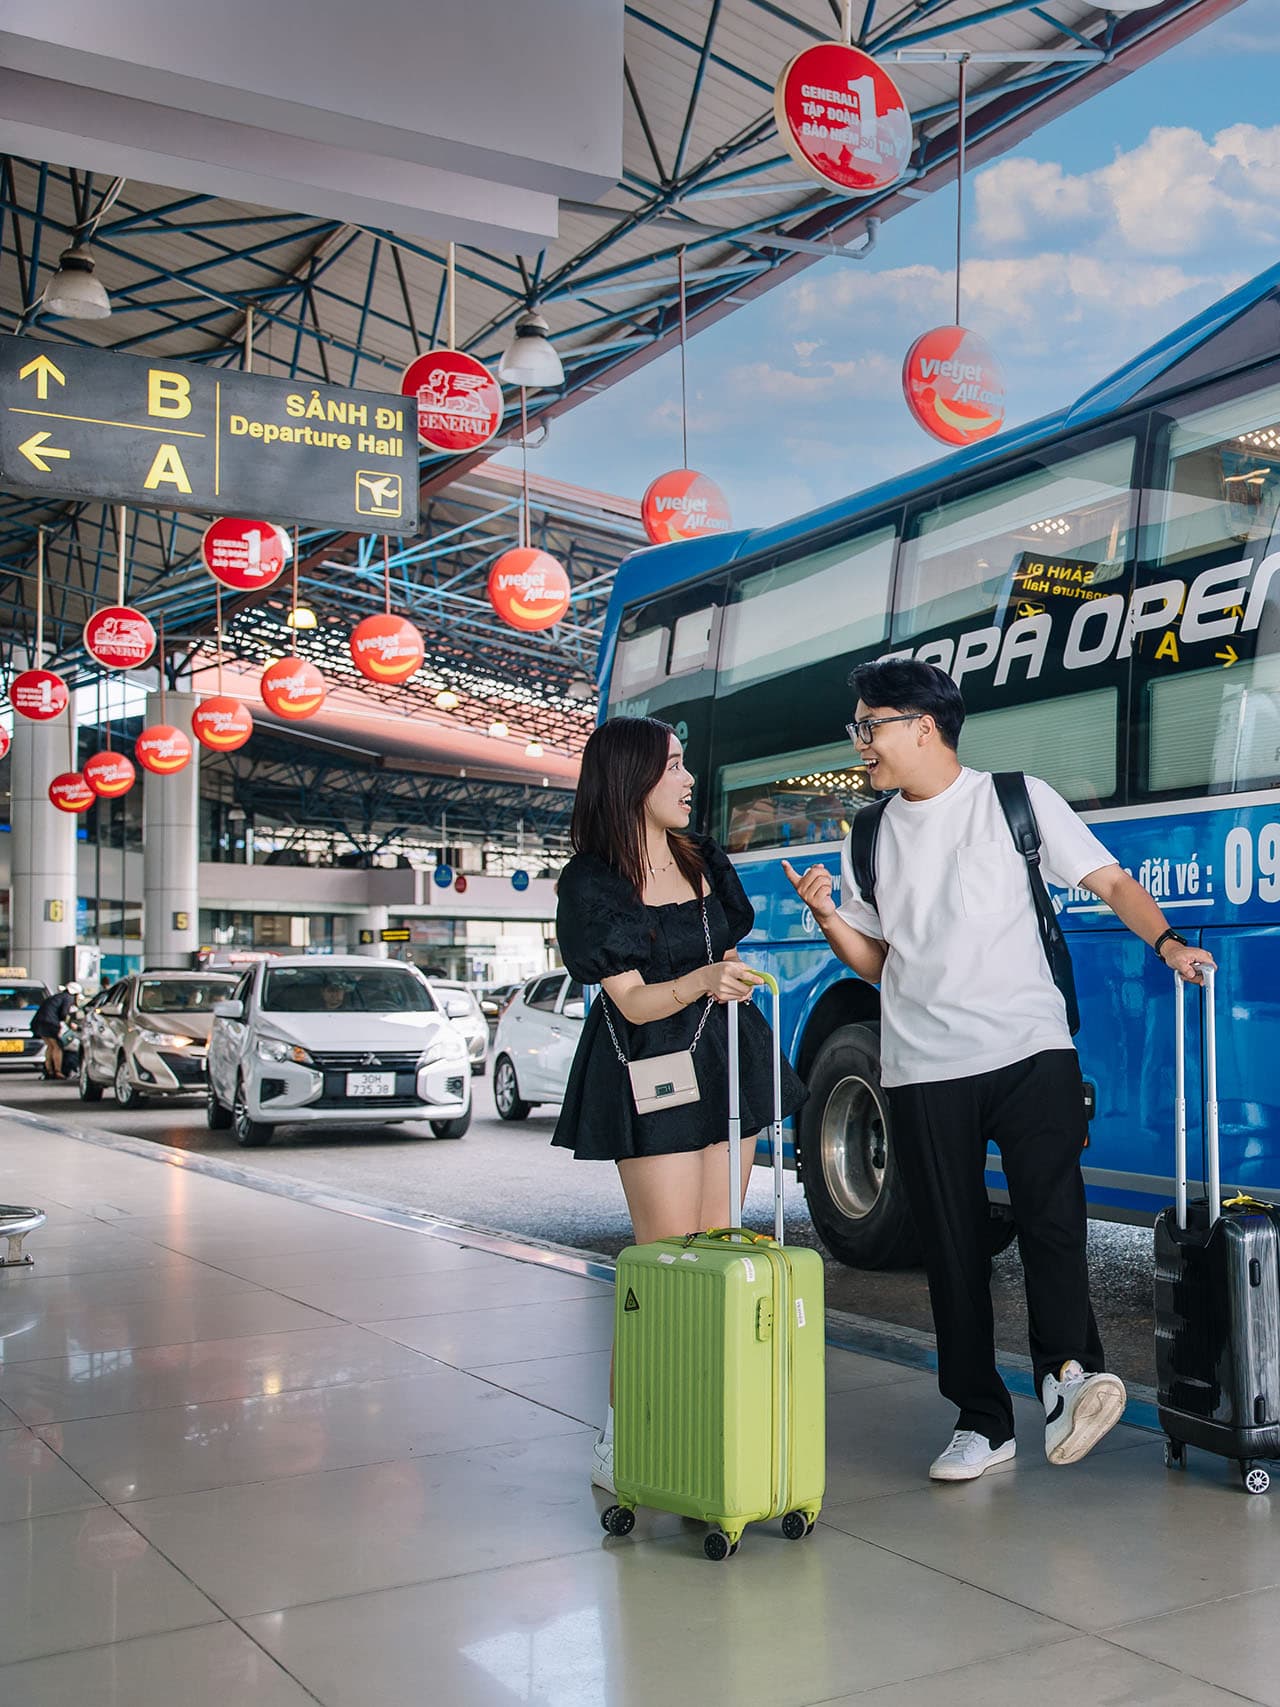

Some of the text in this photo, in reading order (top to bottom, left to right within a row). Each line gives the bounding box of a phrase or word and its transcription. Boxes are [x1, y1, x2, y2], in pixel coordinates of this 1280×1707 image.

[801, 84, 858, 108] GENERALI
[801, 101, 824, 119] TẬP
[919, 357, 982, 385] Vietjet
[148, 369, 403, 432] B SẢNH ĐI
[230, 415, 403, 457] Departure Hall
[143, 443, 193, 494] A
[655, 496, 708, 515] Vietjet
[241, 529, 264, 577] 1
[1176, 852, 1200, 896] vé
[51, 900, 63, 922] 6
[176, 912, 188, 930] 5
